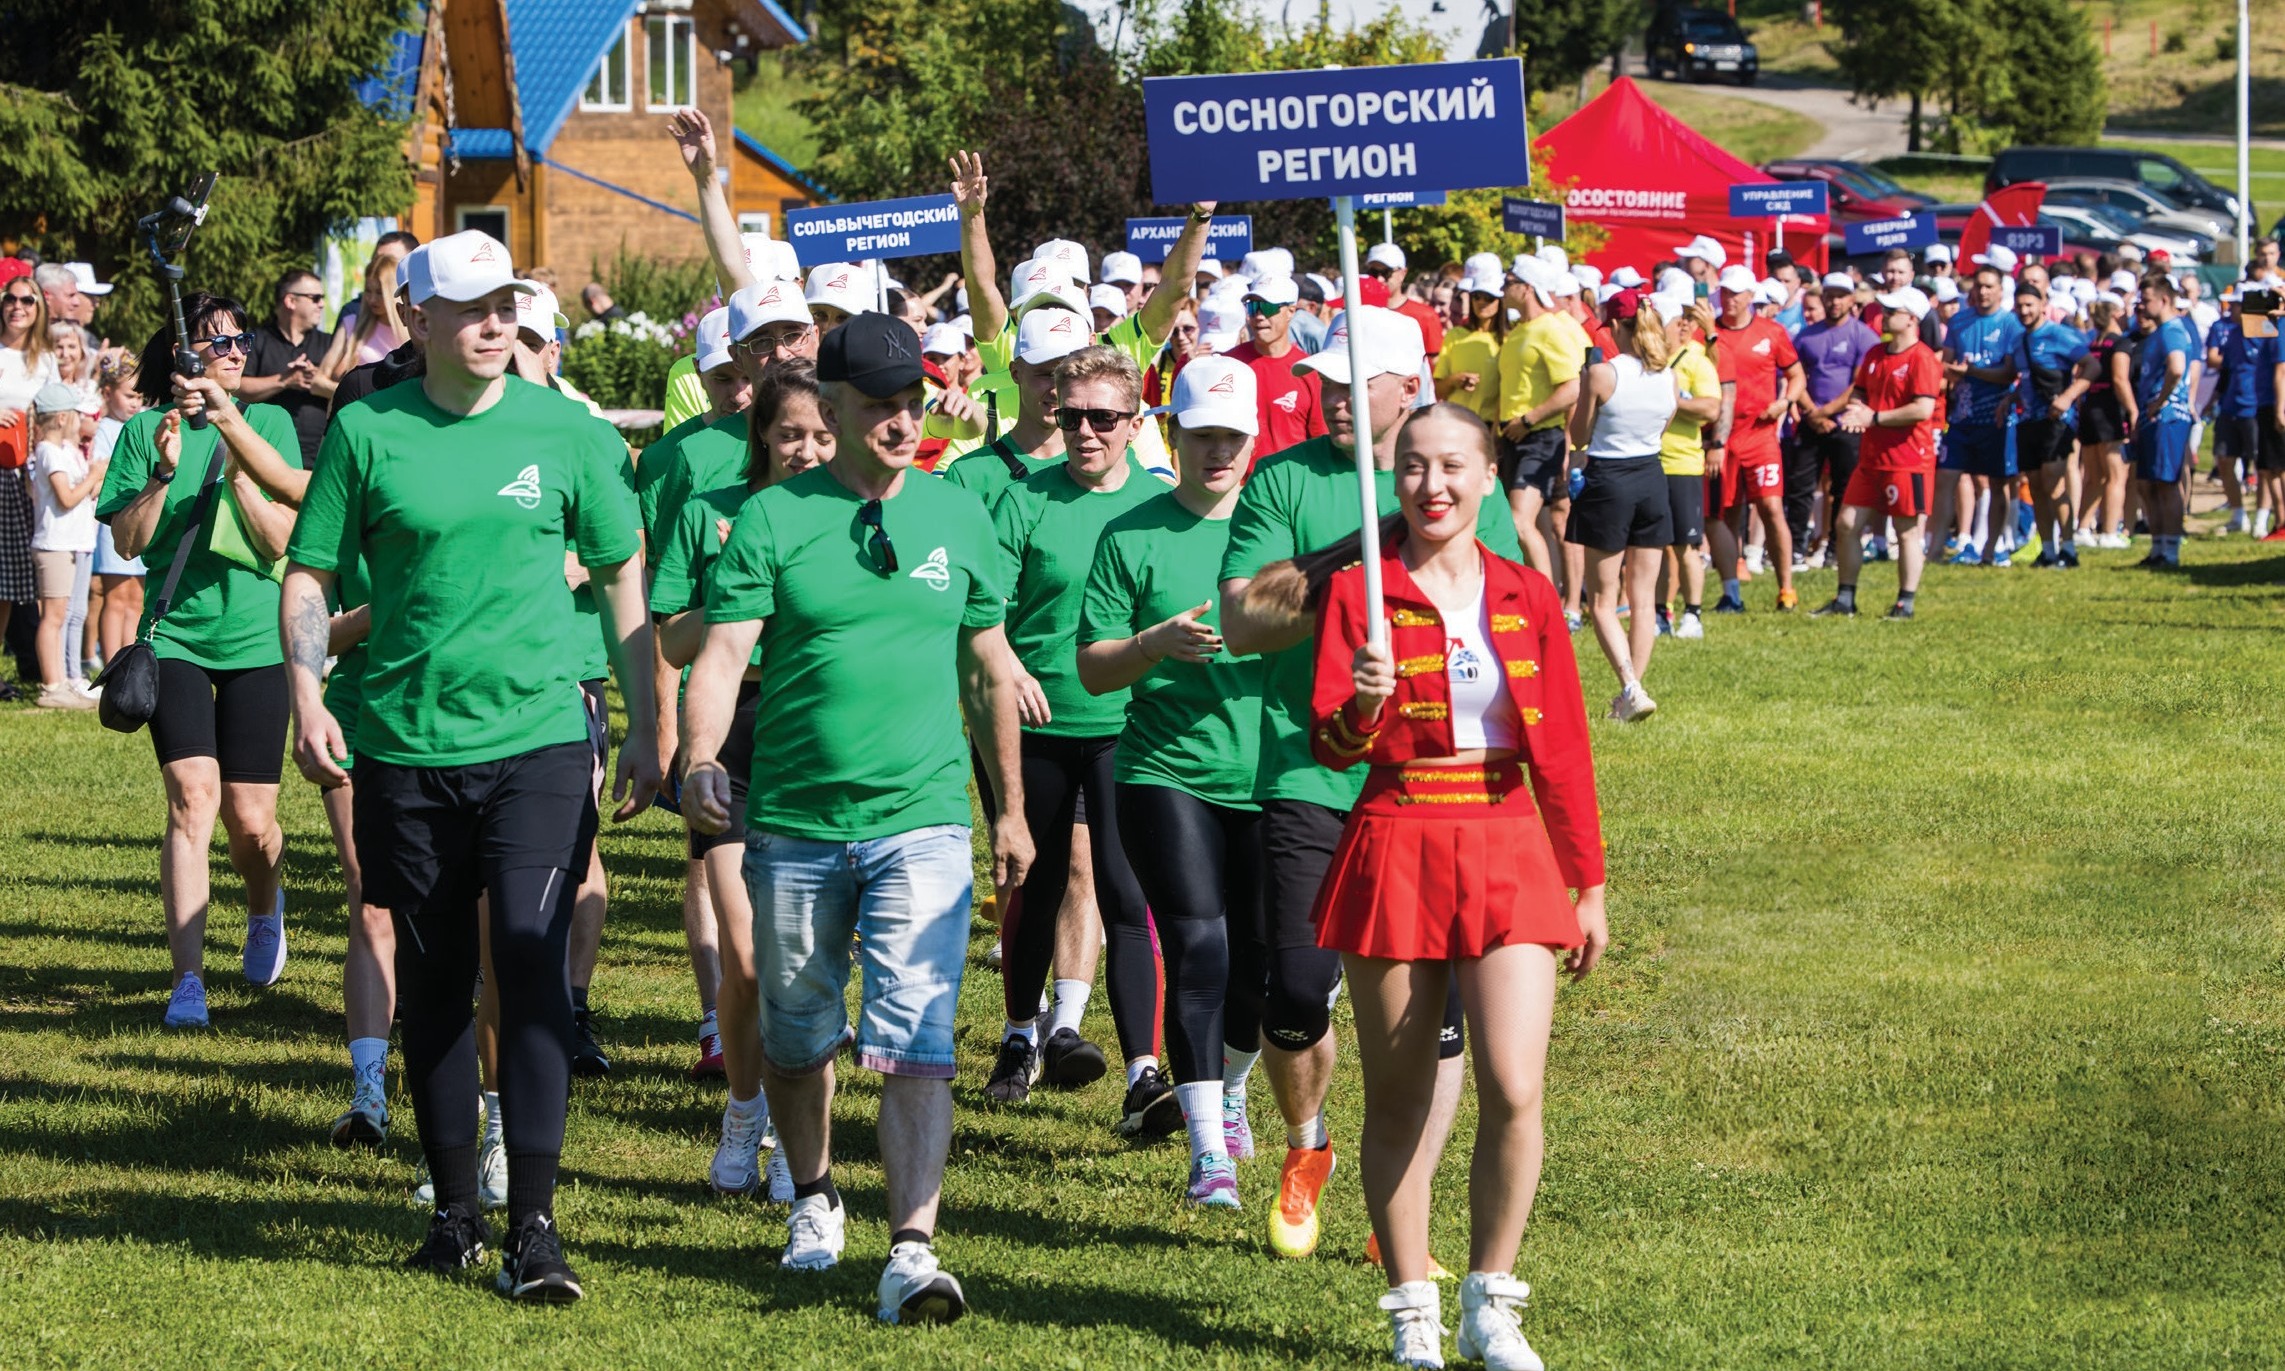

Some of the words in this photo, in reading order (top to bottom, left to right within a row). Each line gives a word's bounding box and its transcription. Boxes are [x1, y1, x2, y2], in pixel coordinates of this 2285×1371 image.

[1173, 77, 1496, 135] СОСНОГОРСКИЙ
[1257, 142, 1417, 183] РЕГИОН
[1363, 191, 1415, 204] РЕГИОН
[1567, 188, 1687, 209] ОСОСТОЯНИЕ
[1742, 189, 1814, 201] УПРАВЛЕНИЕ
[793, 204, 959, 237] СОЛЬВЫЧЕГОДСКИЙ
[1131, 221, 1248, 240] АРХАНГСКИЙ
[846, 232, 911, 252] РЕГИОН
[1755, 463, 1780, 487] 13
[1886, 484, 1899, 506] 9
